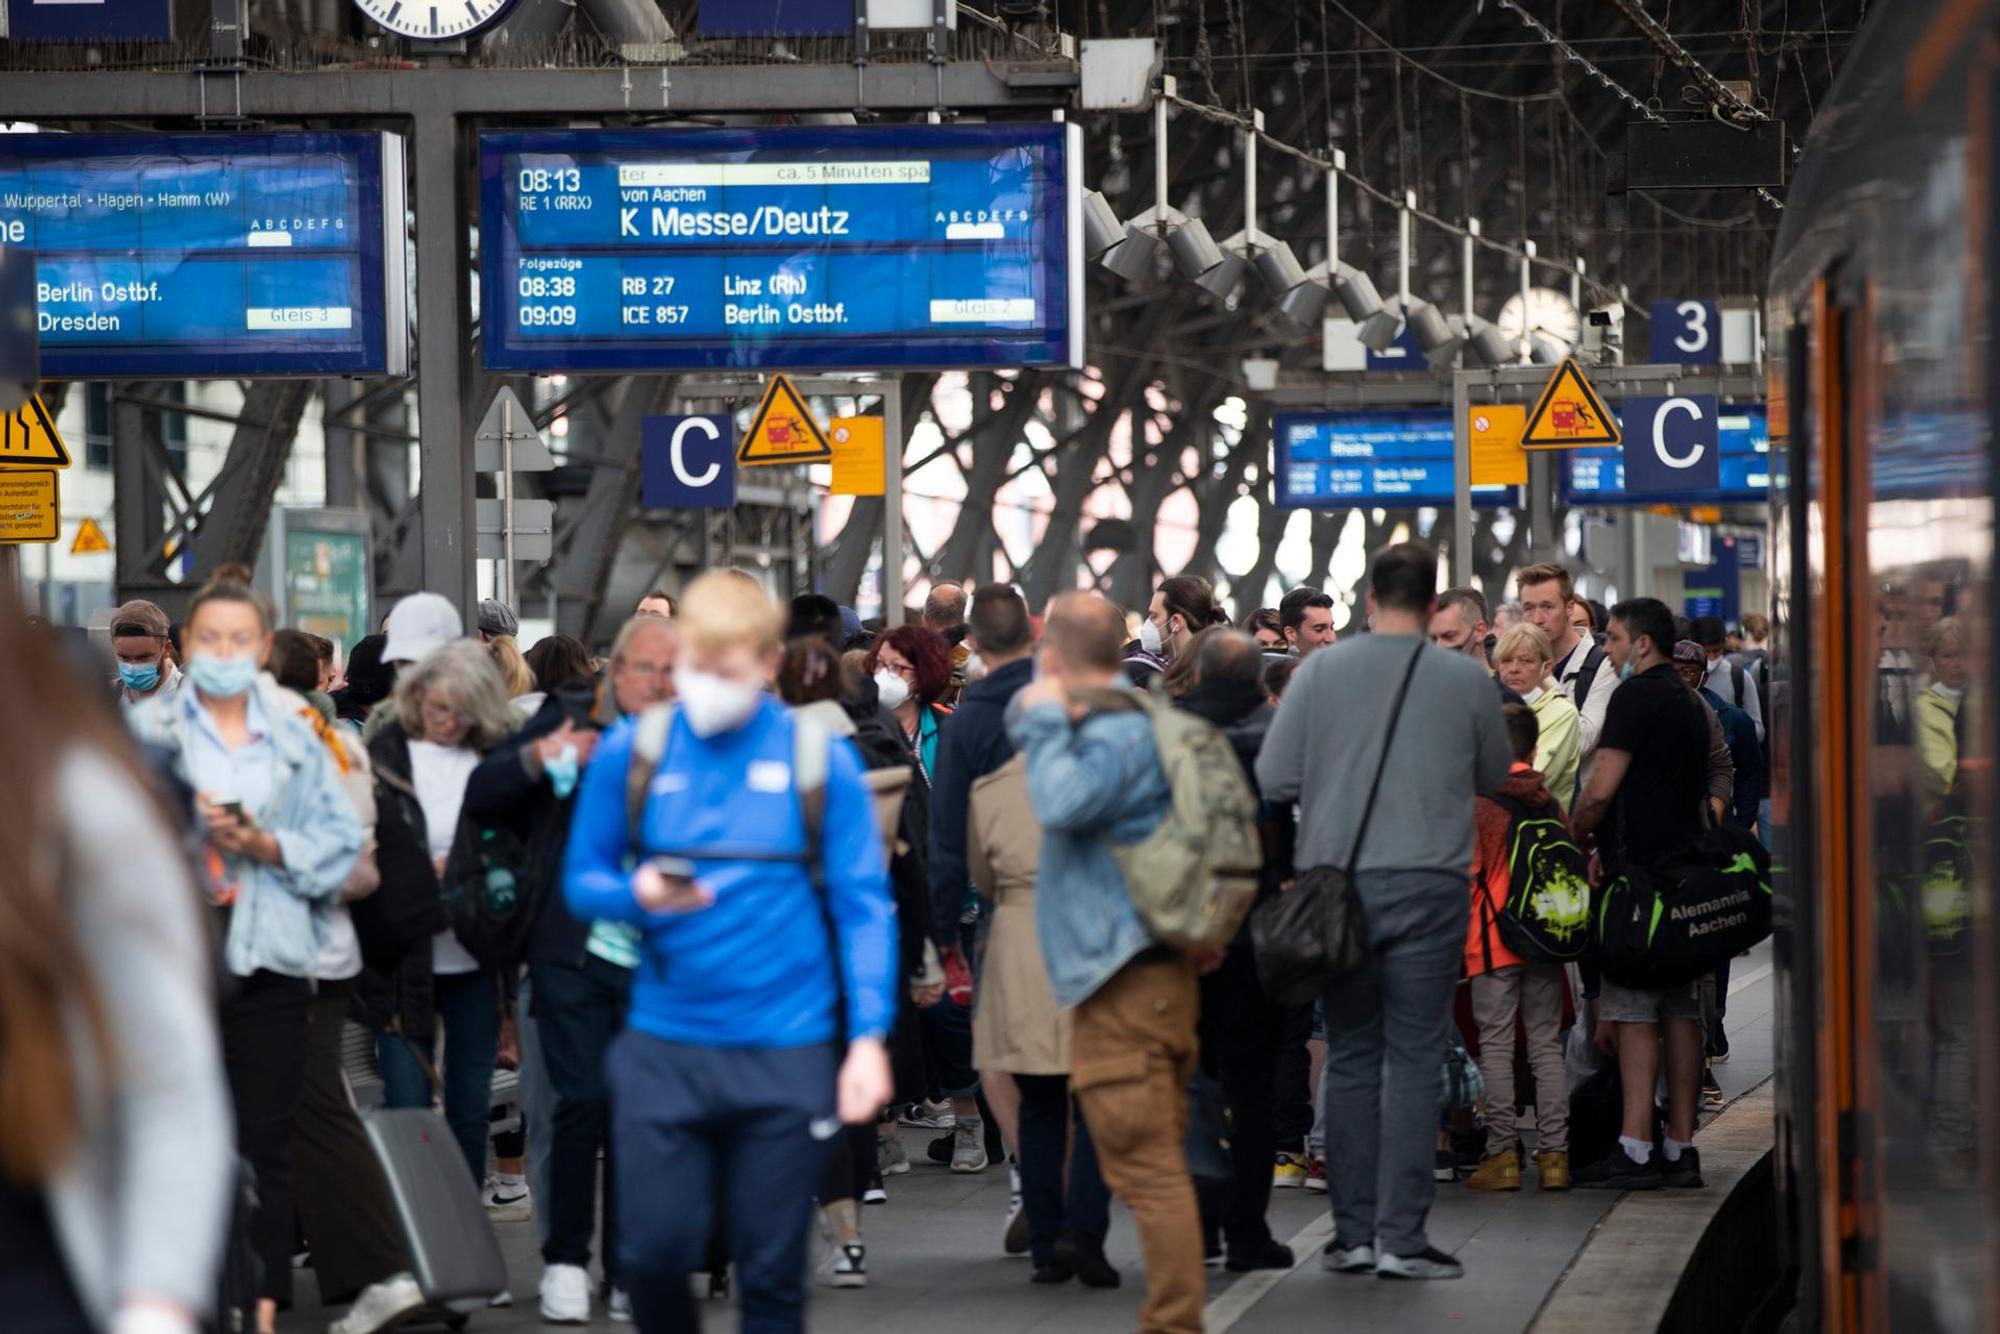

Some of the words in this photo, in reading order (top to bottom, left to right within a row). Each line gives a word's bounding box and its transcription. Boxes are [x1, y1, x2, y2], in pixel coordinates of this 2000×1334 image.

[520, 169, 580, 192] 08:13
[622, 167, 646, 181] ter
[777, 168, 801, 179] ca.
[807, 166, 816, 178] 5
[823, 165, 892, 178] Minuten
[899, 166, 929, 181] spa
[4, 193, 82, 211] Wuppertal
[98, 193, 143, 211] Hagen
[158, 192, 200, 206] Hamm
[205, 192, 230, 207] (W)
[520, 196, 537, 210] RE
[543, 195, 550, 210] 1
[554, 195, 592, 210] (RRX)
[621, 189, 648, 202] von
[652, 187, 706, 202] Aachen
[621, 207, 640, 236] K
[652, 205, 849, 236] Messe/Deutz
[519, 258, 583, 271] Folgezüge
[37, 283, 93, 302] Berlin
[101, 282, 162, 301] Ostbf.
[519, 277, 576, 297] 08:38
[622, 277, 647, 295] RB
[652, 277, 675, 295] 27
[724, 275, 762, 295] Linz
[769, 274, 807, 295] (Rh)
[271, 308, 313, 322] Gleis
[319, 308, 329, 322] 3
[520, 306, 577, 326] 09:09
[622, 306, 650, 324] ICE
[656, 305, 689, 324] 857
[724, 304, 780, 324] Berlin
[788, 303, 848, 323] Ostbf.
[954, 301, 997, 314] Gleis
[38, 312, 120, 331] Dresden
[1674, 301, 1709, 353] 3
[1652, 397, 1705, 469] C
[670, 416, 721, 488] C
[1671, 889, 1750, 920] Alemannia
[1688, 911, 1747, 938] Aachen
